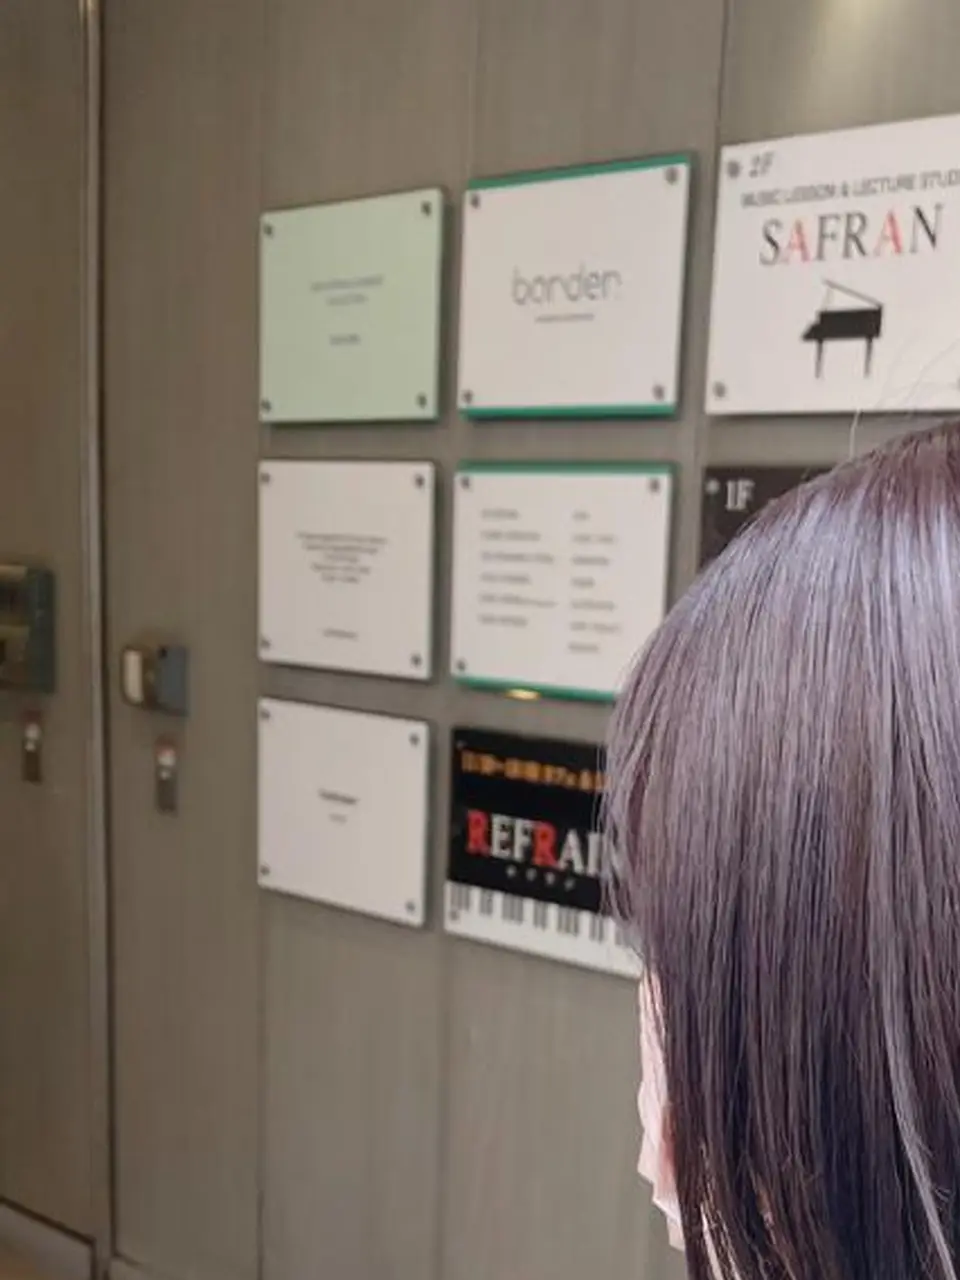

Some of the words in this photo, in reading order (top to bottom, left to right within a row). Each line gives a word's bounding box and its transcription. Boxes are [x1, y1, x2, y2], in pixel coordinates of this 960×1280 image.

[853, 174, 916, 197] LECTURE
[758, 203, 944, 267] SAFRAN
[465, 809, 605, 877] REFRAI
